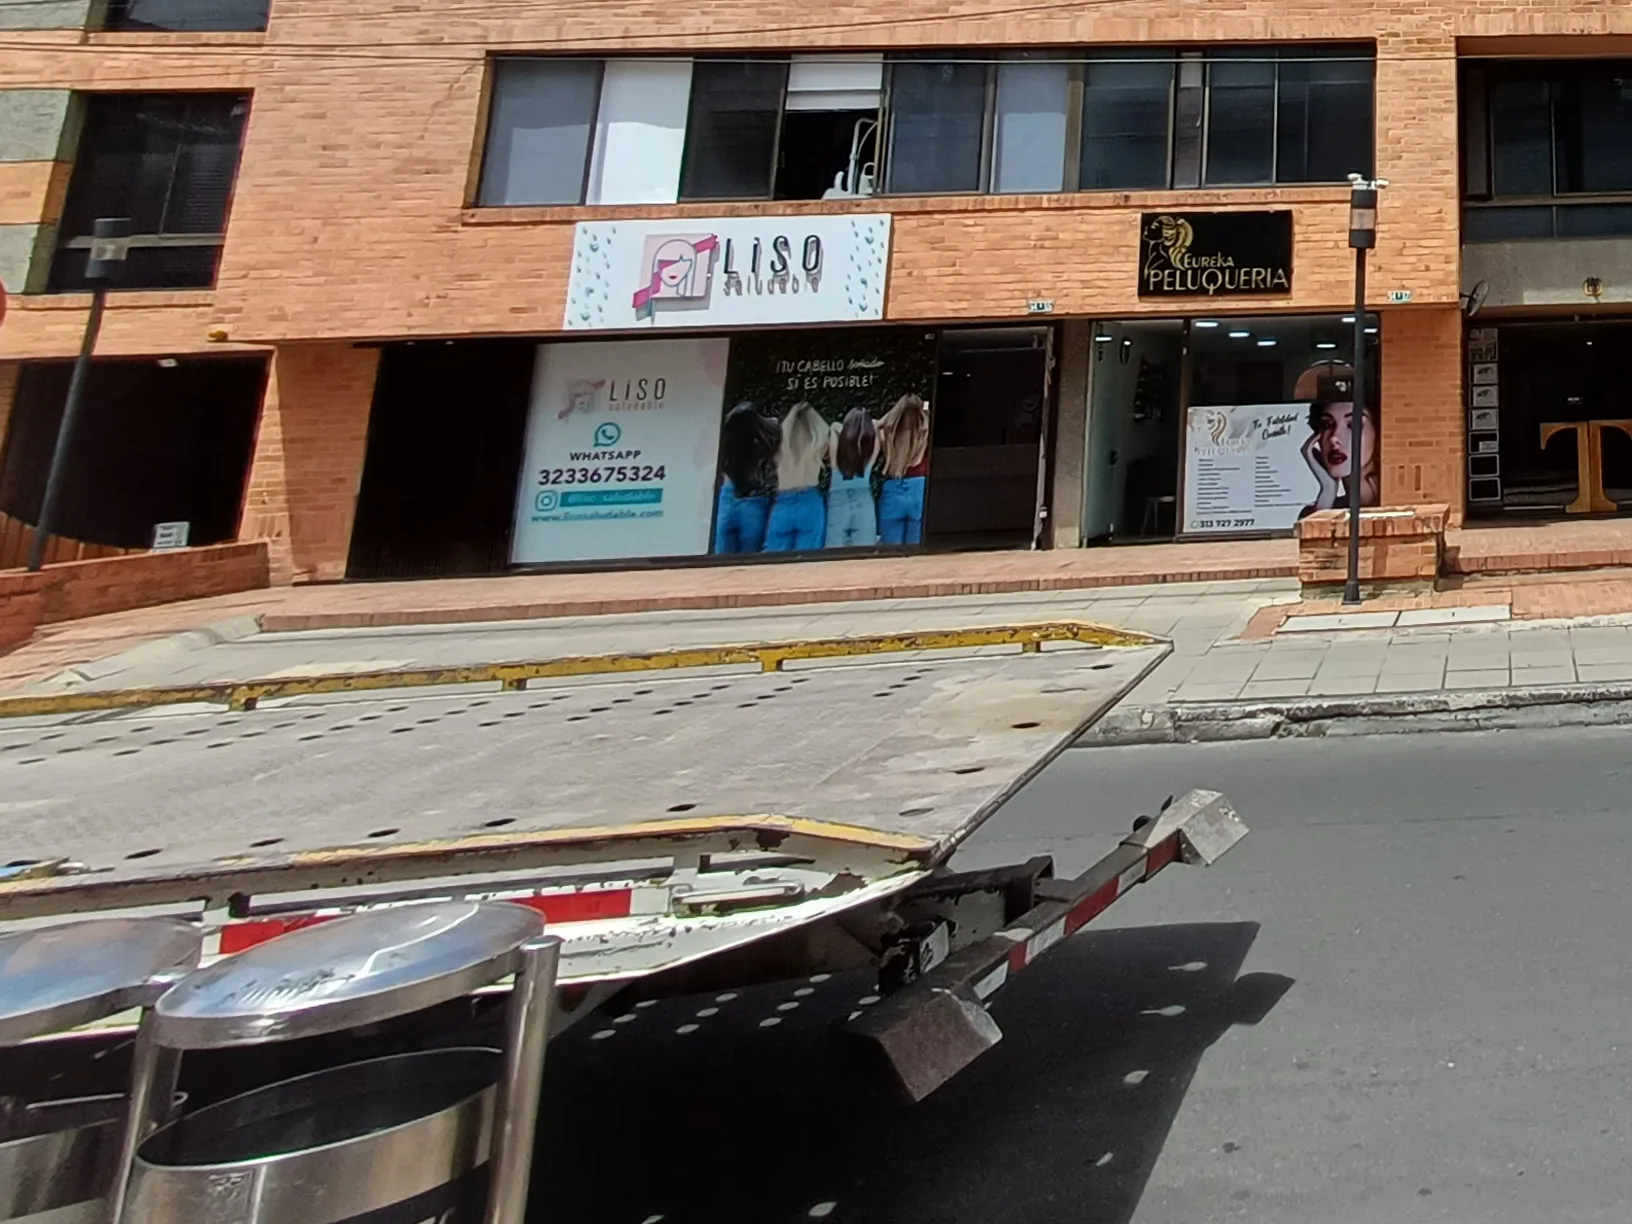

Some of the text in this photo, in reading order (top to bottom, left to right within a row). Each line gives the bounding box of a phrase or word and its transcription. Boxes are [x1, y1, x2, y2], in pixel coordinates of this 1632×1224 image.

[1150, 267, 1289, 295] PELUQUERIA
[797, 359, 845, 373] CABELLO
[804, 377, 818, 390] ES
[569, 450, 642, 462] WHATSAPP
[537, 465, 667, 486] 3233675324
